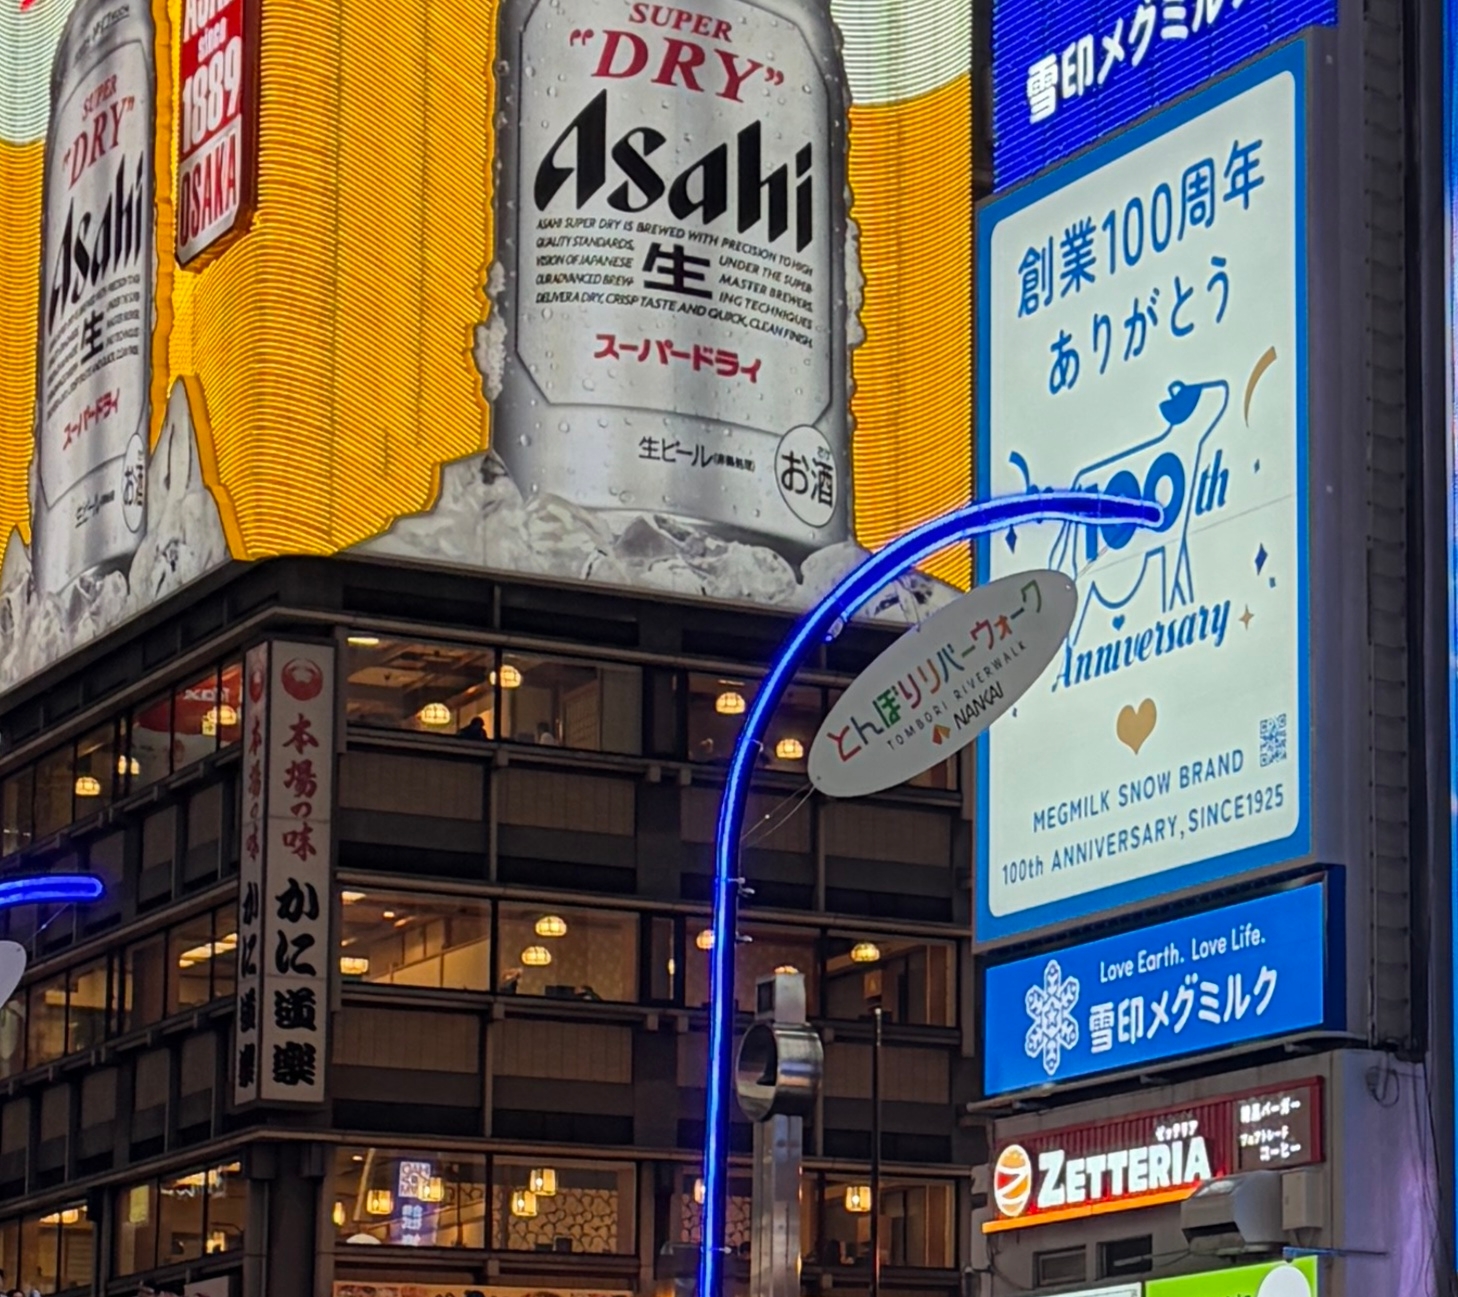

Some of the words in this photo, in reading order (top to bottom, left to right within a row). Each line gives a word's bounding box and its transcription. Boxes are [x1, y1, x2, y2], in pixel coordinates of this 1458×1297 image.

[629, 2, 732, 43] SUPER
[182, 36, 242, 153] 1889
[179, 133, 239, 246] OSAKA
[534, 89, 813, 253] Asahi
[48, 151, 144, 335] Asahi
[536, 236, 571, 248] QUALITY
[564, 217, 596, 229] SUPER
[599, 218, 620, 230] DRY
[624, 220, 633, 231] IS
[637, 222, 685, 239] BREWED
[688, 230, 719, 246] WITH
[721, 237, 776, 262] PRECISION
[779, 254, 791, 267] TO
[1018, 139, 1265, 318] 創業100周年
[566, 255, 579, 266] OF
[579, 255, 635, 269] JAPANESE
[642, 243, 713, 299] 生
[719, 255, 759, 274] UNDER
[762, 265, 782, 282] THE
[719, 274, 768, 298] MASTER
[640, 296, 676, 312] TASTE
[678, 301, 706, 317] AND
[749, 318, 783, 337] CLEAN
[719, 291, 742, 308] ING
[744, 297, 813, 330] TECHNIQUES
[1048, 256, 1230, 395] ありがとう
[594, 333, 762, 382] スーパードライ
[781, 450, 833, 508] お酒
[827, 579, 1042, 761] とんぼりリバーウォーク
[1051, 600, 1230, 692] Anniversary
[887, 701, 948, 751] TOMBORI
[953, 640, 1027, 701] RIVERWALK
[953, 681, 1005, 731] NANKAI
[282, 713, 316, 861] 本場の味
[1033, 780, 1111, 833] MEGMILK
[1117, 771, 1171, 808] SNOW
[1179, 749, 1244, 789] BRAND
[1002, 854, 1044, 886] 100th
[1188, 783, 1285, 833] SINCE1925
[1100, 959, 1134, 984] Love
[1137, 942, 1185, 974] Earth.
[1191, 936, 1227, 962] Love
[1231, 923, 1266, 953] Life.
[1089, 964, 1278, 1054] 雪印メグミルク
[1155, 1120, 1199, 1141] ゼッテリア
[1260, 1141, 1301, 1162] コーヒー
[1038, 1136, 1213, 1209] ZETTERIA
